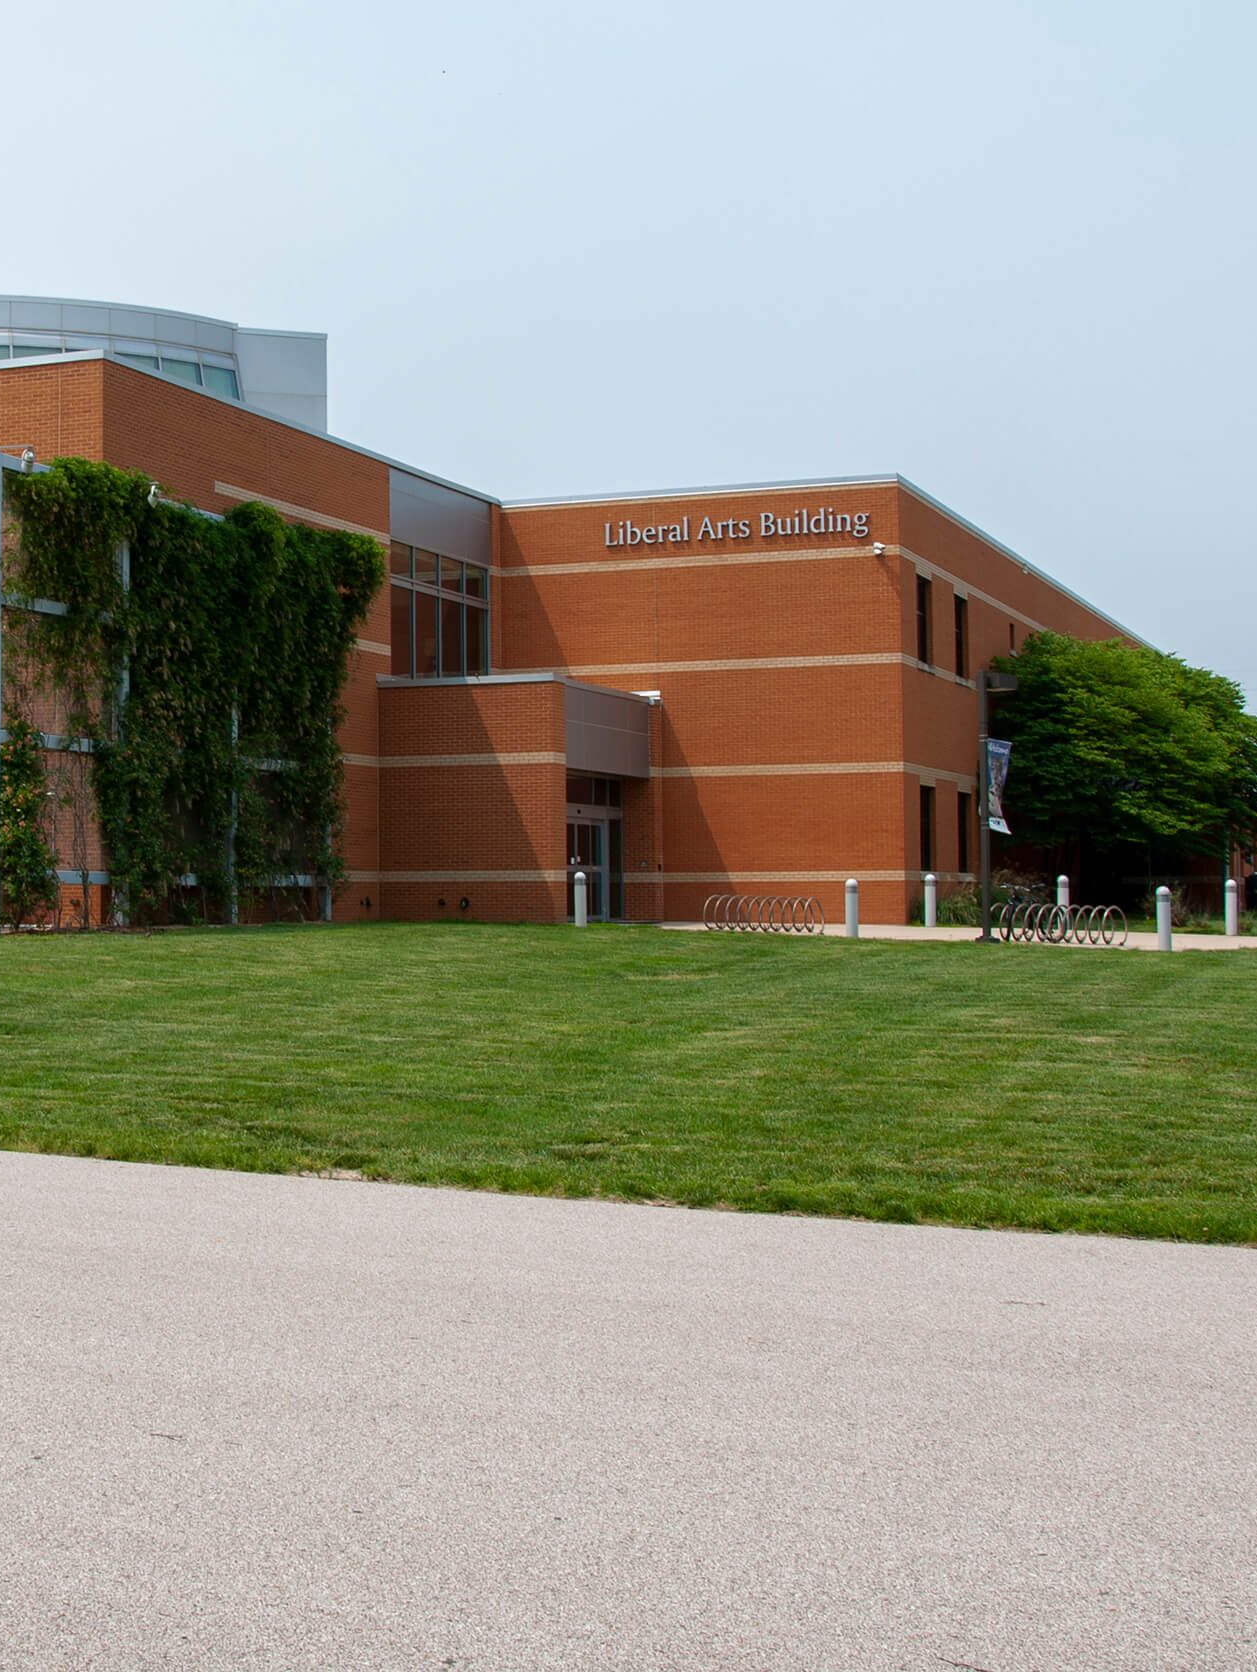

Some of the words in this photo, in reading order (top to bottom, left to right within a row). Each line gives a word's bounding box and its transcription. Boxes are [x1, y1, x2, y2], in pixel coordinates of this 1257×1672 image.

[604, 516, 689, 546] Liberal
[697, 515, 750, 541] Arts
[759, 507, 870, 537] Building
